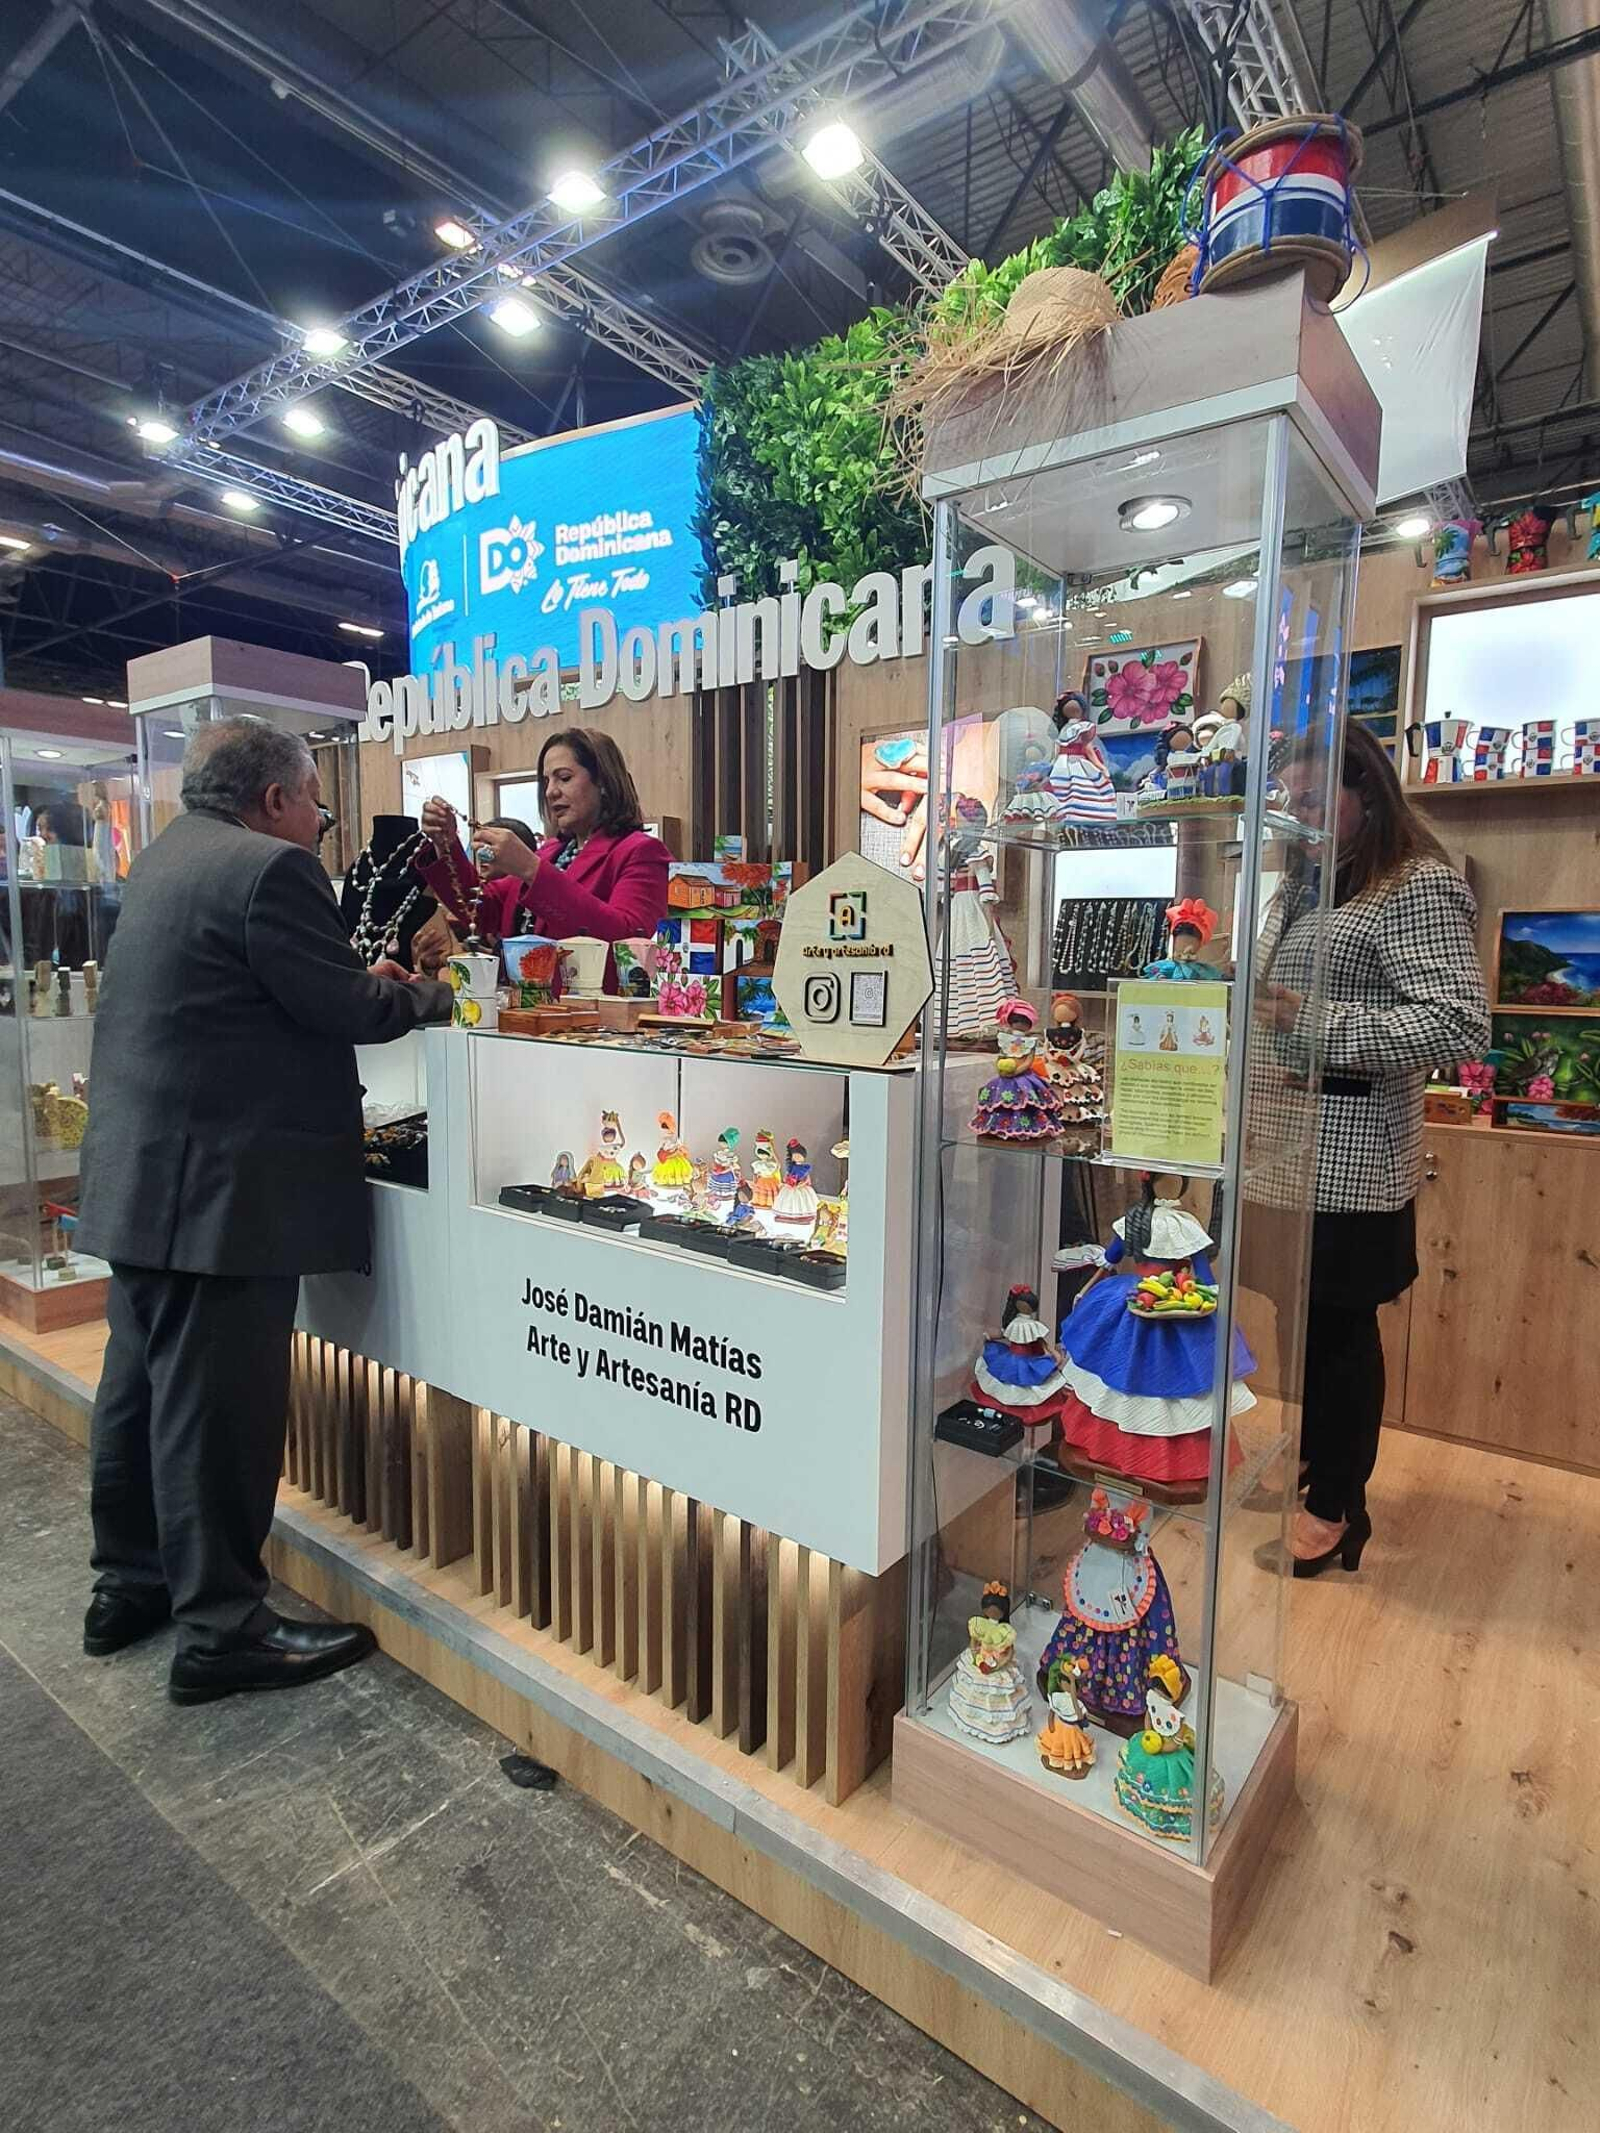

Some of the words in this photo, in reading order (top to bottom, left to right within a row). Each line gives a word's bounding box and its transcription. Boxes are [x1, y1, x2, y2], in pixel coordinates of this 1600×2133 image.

[554, 509, 653, 545] República
[555, 529, 674, 567] Dominicana
[541, 578, 565, 614] Lo
[563, 573, 609, 611] Tiene
[610, 566, 651, 599] Todo
[521, 1277, 569, 1317] José
[574, 1292, 664, 1349] Damián
[669, 1320, 763, 1379] Matías
[526, 1324, 571, 1365] Arte
[577, 1347, 590, 1378] y
[595, 1348, 718, 1419] Artesanía
[725, 1390, 762, 1433] RD
